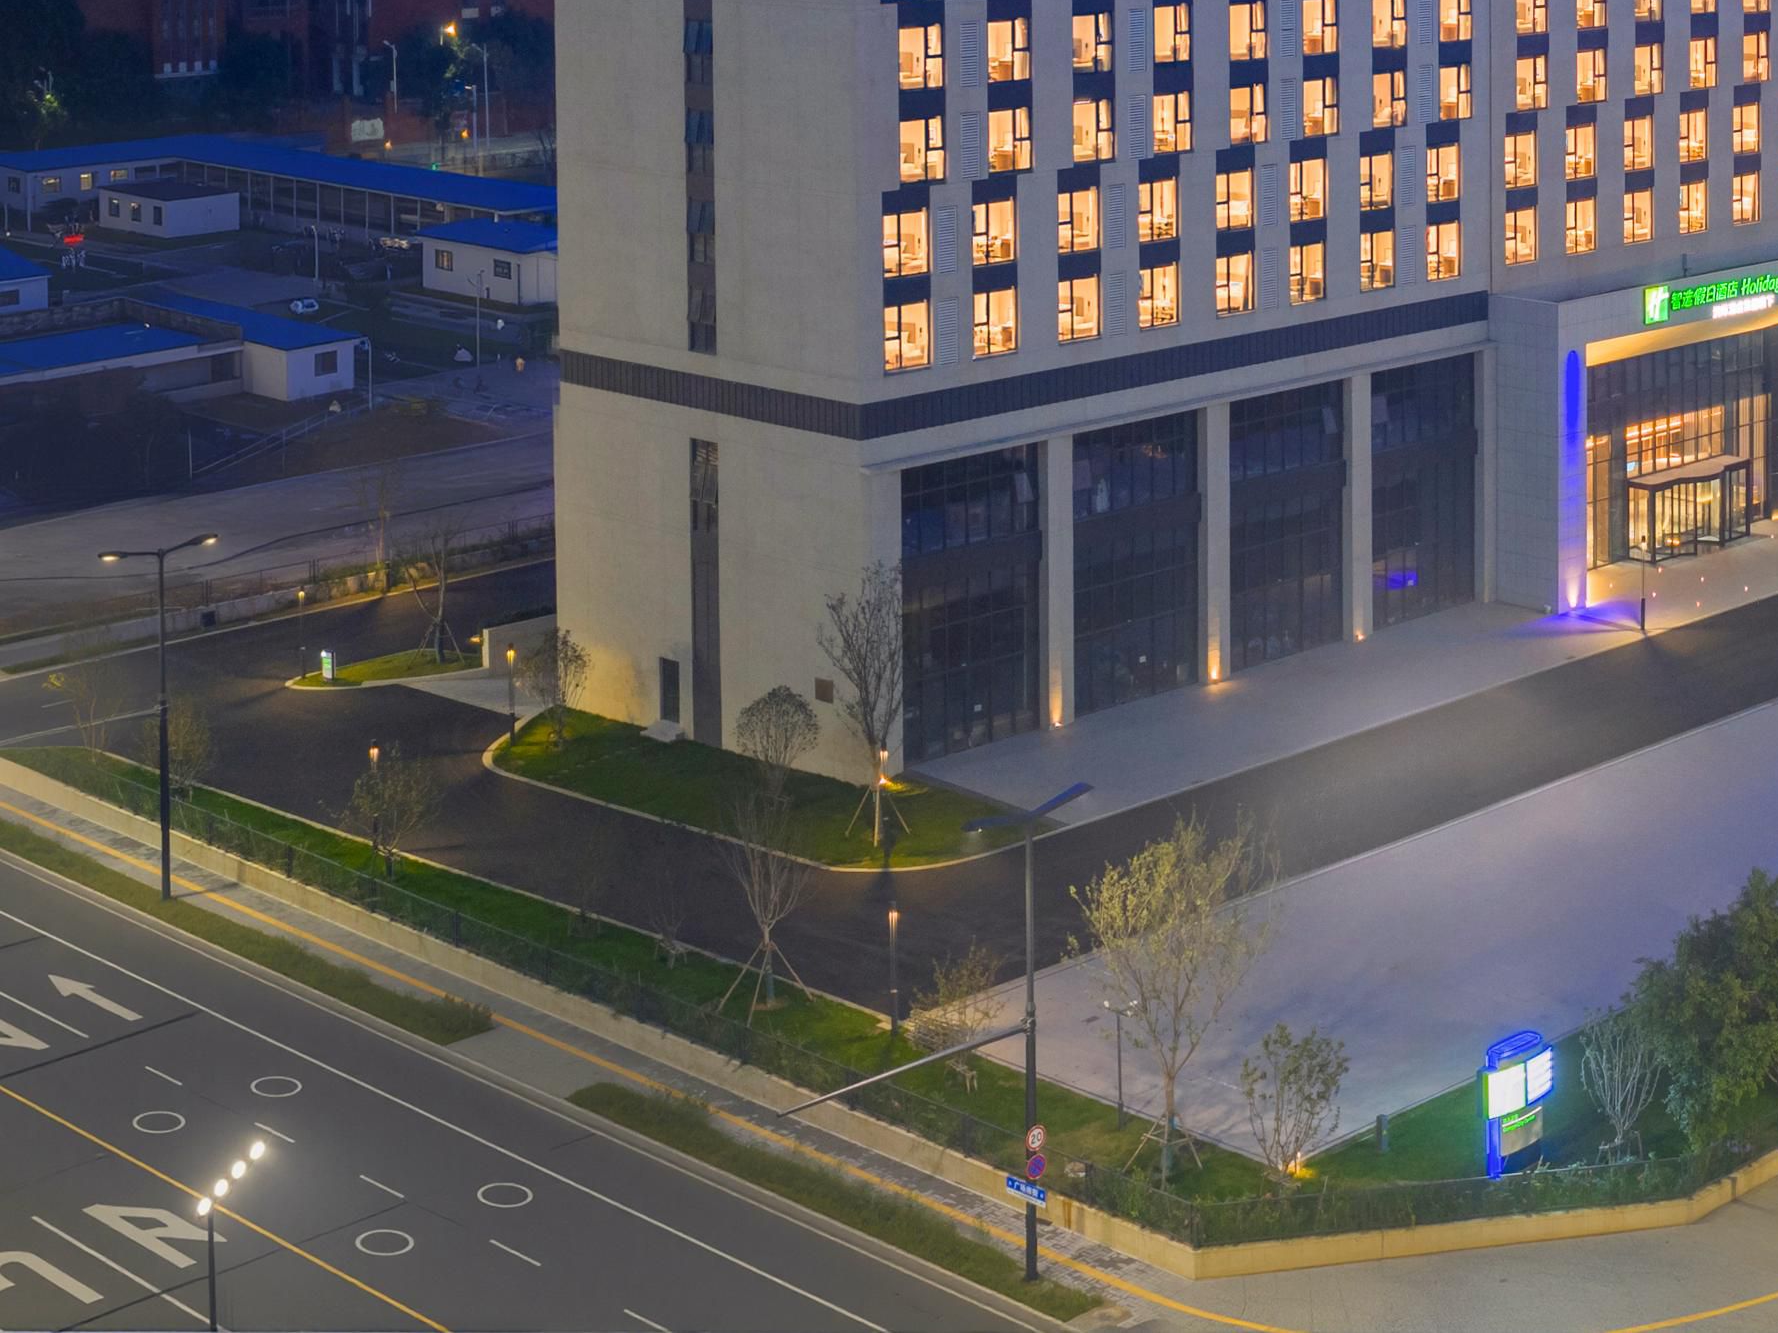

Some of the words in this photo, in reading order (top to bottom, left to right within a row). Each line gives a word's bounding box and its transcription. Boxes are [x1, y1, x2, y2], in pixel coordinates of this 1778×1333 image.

[1670, 280, 1739, 311] 智选假日酒店
[1030, 1131, 1042, 1145] 20
